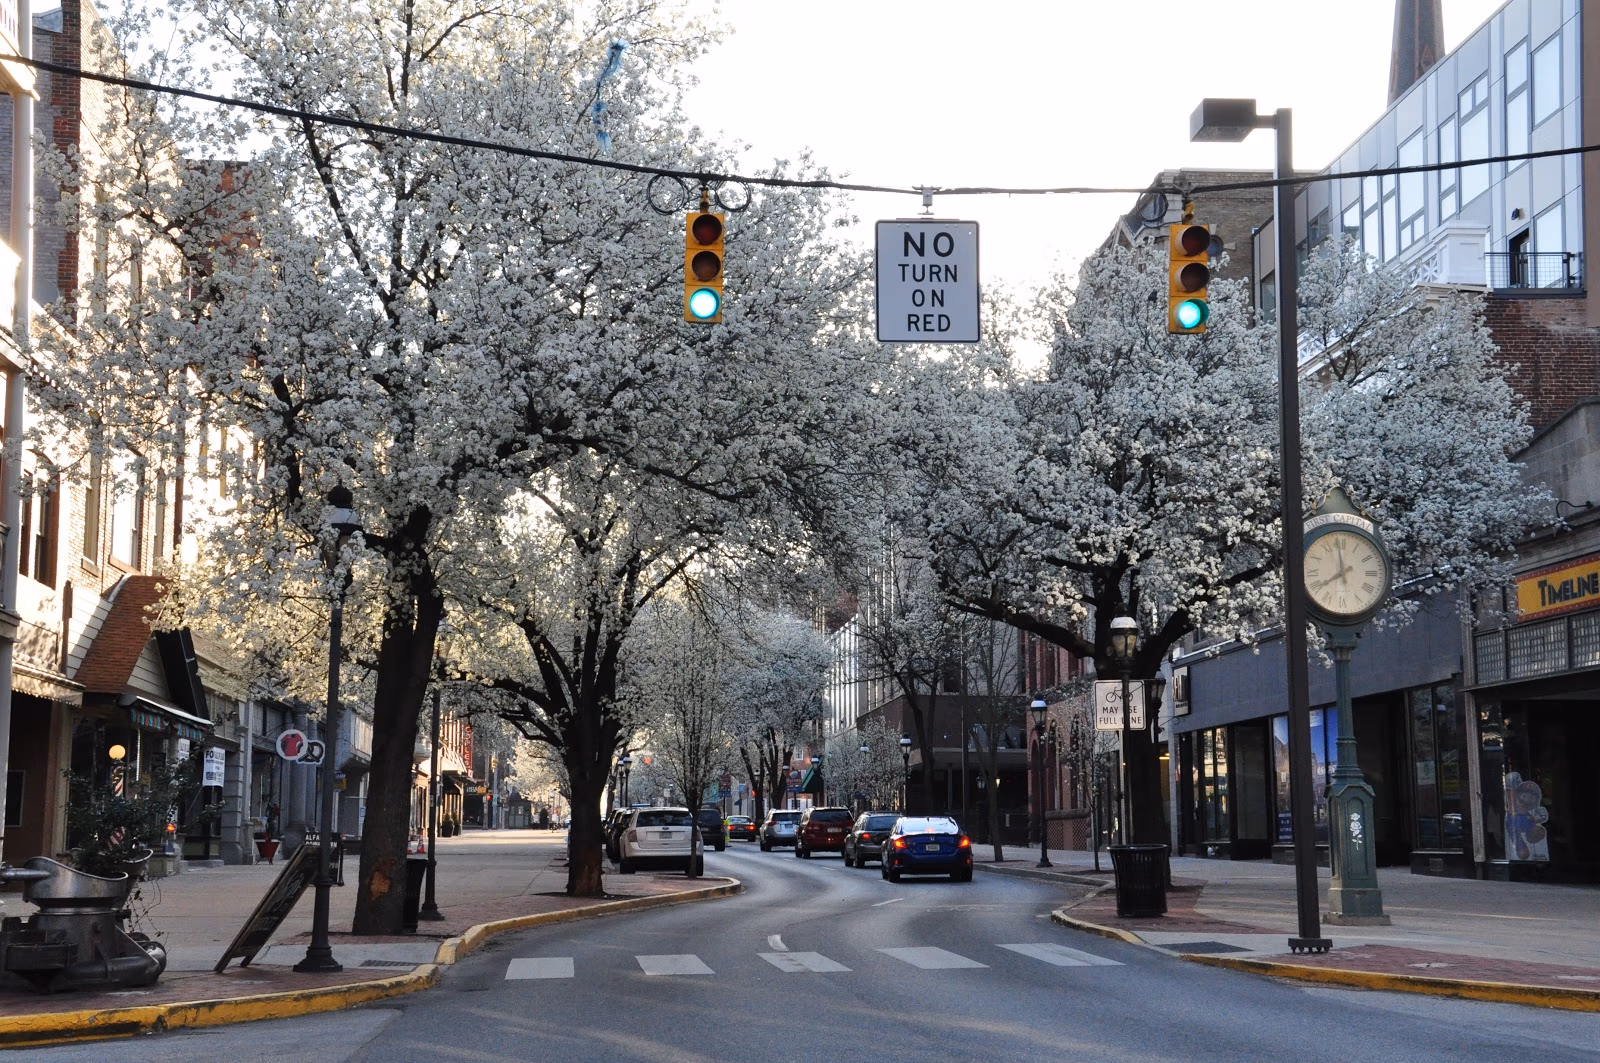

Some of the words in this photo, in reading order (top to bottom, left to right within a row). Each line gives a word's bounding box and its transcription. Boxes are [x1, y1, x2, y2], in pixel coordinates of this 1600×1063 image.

[904, 231, 955, 258] NO
[898, 263, 958, 283] TURN
[911, 288, 945, 308] ON
[907, 313, 951, 333] RED
[1305, 515, 1331, 530] FIRST
[1333, 514, 1371, 532] CAPITAL
[1538, 572, 1599, 606] TIMELINE
[1102, 706, 1119, 714] MAY
[1099, 717, 1117, 725] FULL
[1121, 716, 1142, 724] LNE
